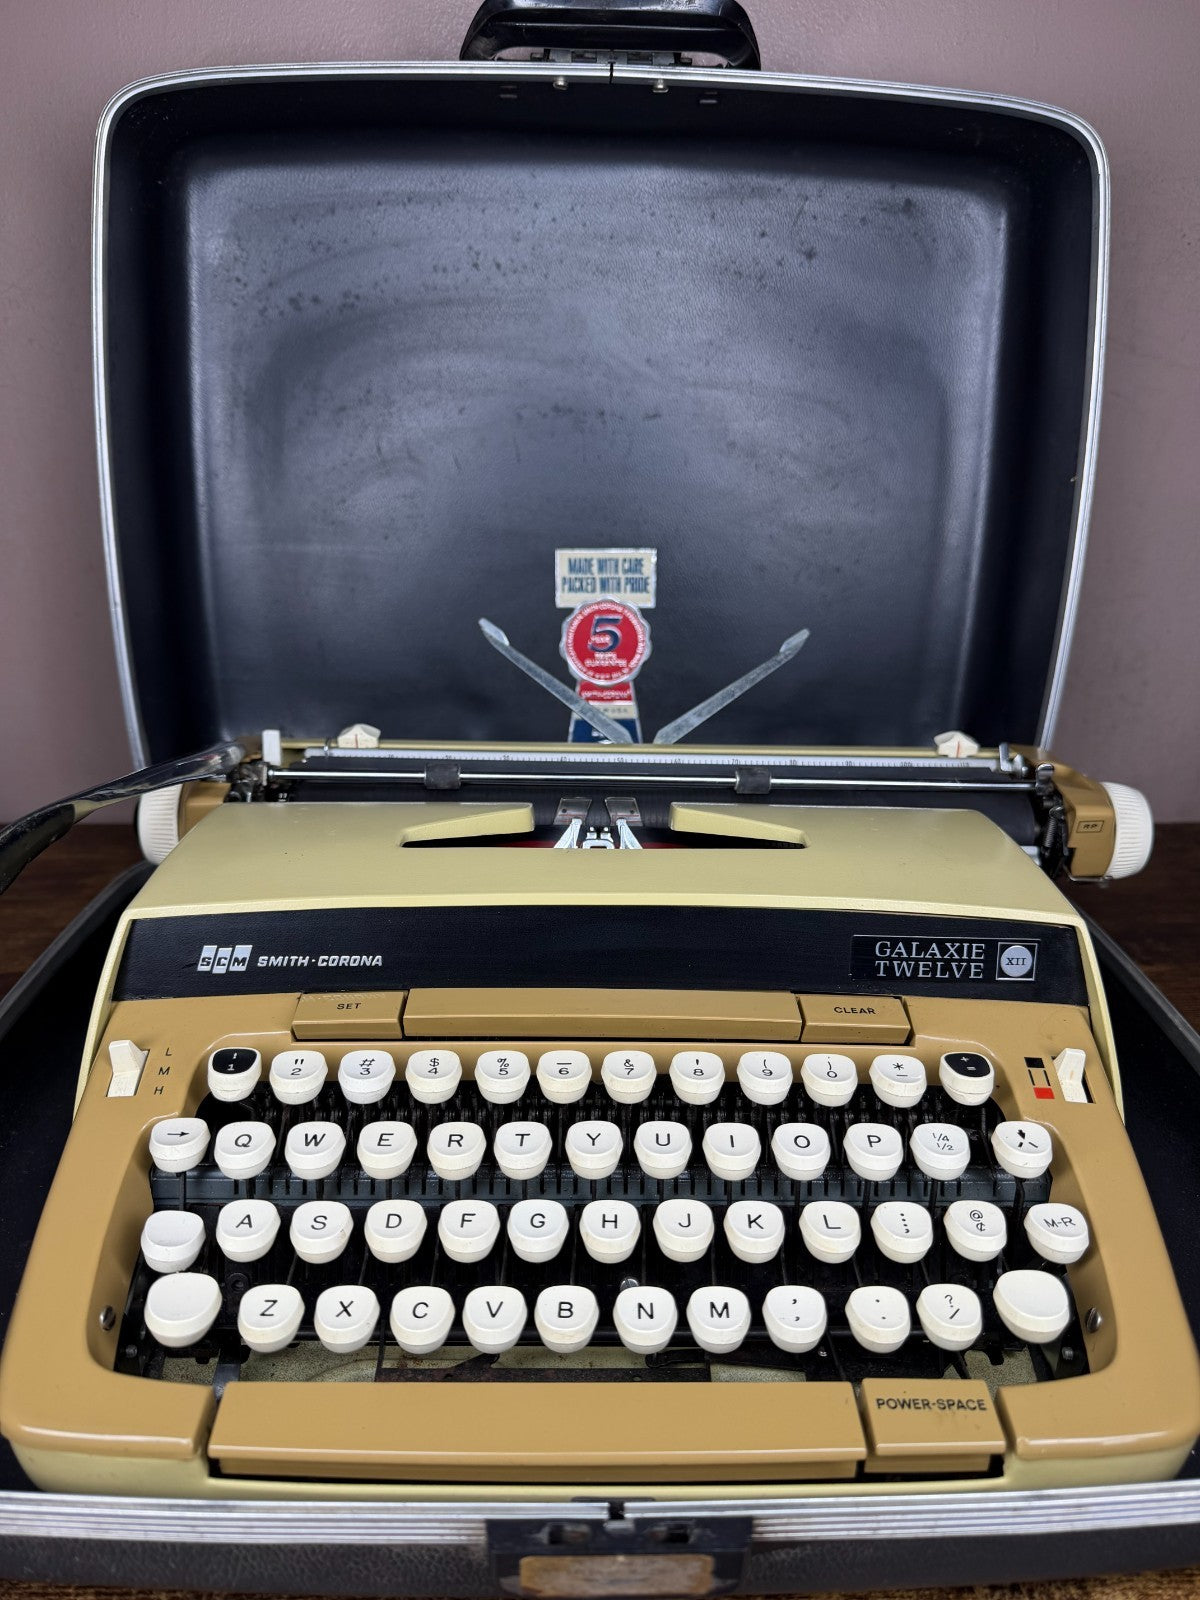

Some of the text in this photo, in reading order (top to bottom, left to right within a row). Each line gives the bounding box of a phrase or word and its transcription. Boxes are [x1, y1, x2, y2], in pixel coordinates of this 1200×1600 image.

[568, 558, 643, 575] MADE WITH CARE
[562, 577, 649, 593] PACKED WITH PRIDE
[587, 614, 622, 652] 5
[875, 941, 985, 960] GALAXIE
[1005, 957, 1027, 966] XII
[875, 960, 984, 979] TWELVE
[834, 1006, 877, 1015] CLEAR
[165, 1047, 173, 1057] L
[360, 1058, 376, 1068] #
[430, 1058, 440, 1068] $
[497, 1058, 510, 1068] %
[624, 1059, 635, 1068] &
[158, 1066, 171, 1076] M
[290, 1067, 302, 1076] 2
[359, 1067, 371, 1076] 3
[427, 1067, 438, 1075] 4
[498, 1067, 509, 1076] 5
[558, 1067, 570, 1076] 6
[624, 1067, 635, 1076] 7
[693, 1068, 705, 1077] 8
[762, 1068, 773, 1077] 9
[153, 1085, 165, 1096] H
[234, 1134, 253, 1148] Q
[304, 1133, 326, 1147] W
[377, 1133, 394, 1147] E
[447, 1133, 464, 1147] R
[515, 1133, 531, 1147] T
[587, 1133, 601, 1147] Y
[655, 1133, 671, 1147] U
[729, 1134, 735, 1148] I
[794, 1135, 811, 1149] O
[867, 1135, 882, 1148] P
[236, 1214, 253, 1229] A
[310, 1215, 328, 1230] S
[385, 1213, 403, 1229] D
[461, 1213, 477, 1229] F
[530, 1213, 546, 1229] G
[602, 1213, 618, 1229] H
[678, 1213, 692, 1228] J
[747, 1214, 764, 1229] K
[822, 1214, 842, 1230] L
[969, 1209, 984, 1222] @
[1043, 1216, 1076, 1229] M-R
[944, 1294, 954, 1308] ?
[260, 1300, 278, 1317] Z
[335, 1300, 354, 1318] X
[412, 1301, 429, 1319] C
[486, 1301, 504, 1319] V
[557, 1301, 574, 1319] B
[637, 1302, 654, 1320] N
[710, 1301, 730, 1319] M
[949, 1308, 961, 1320] /
